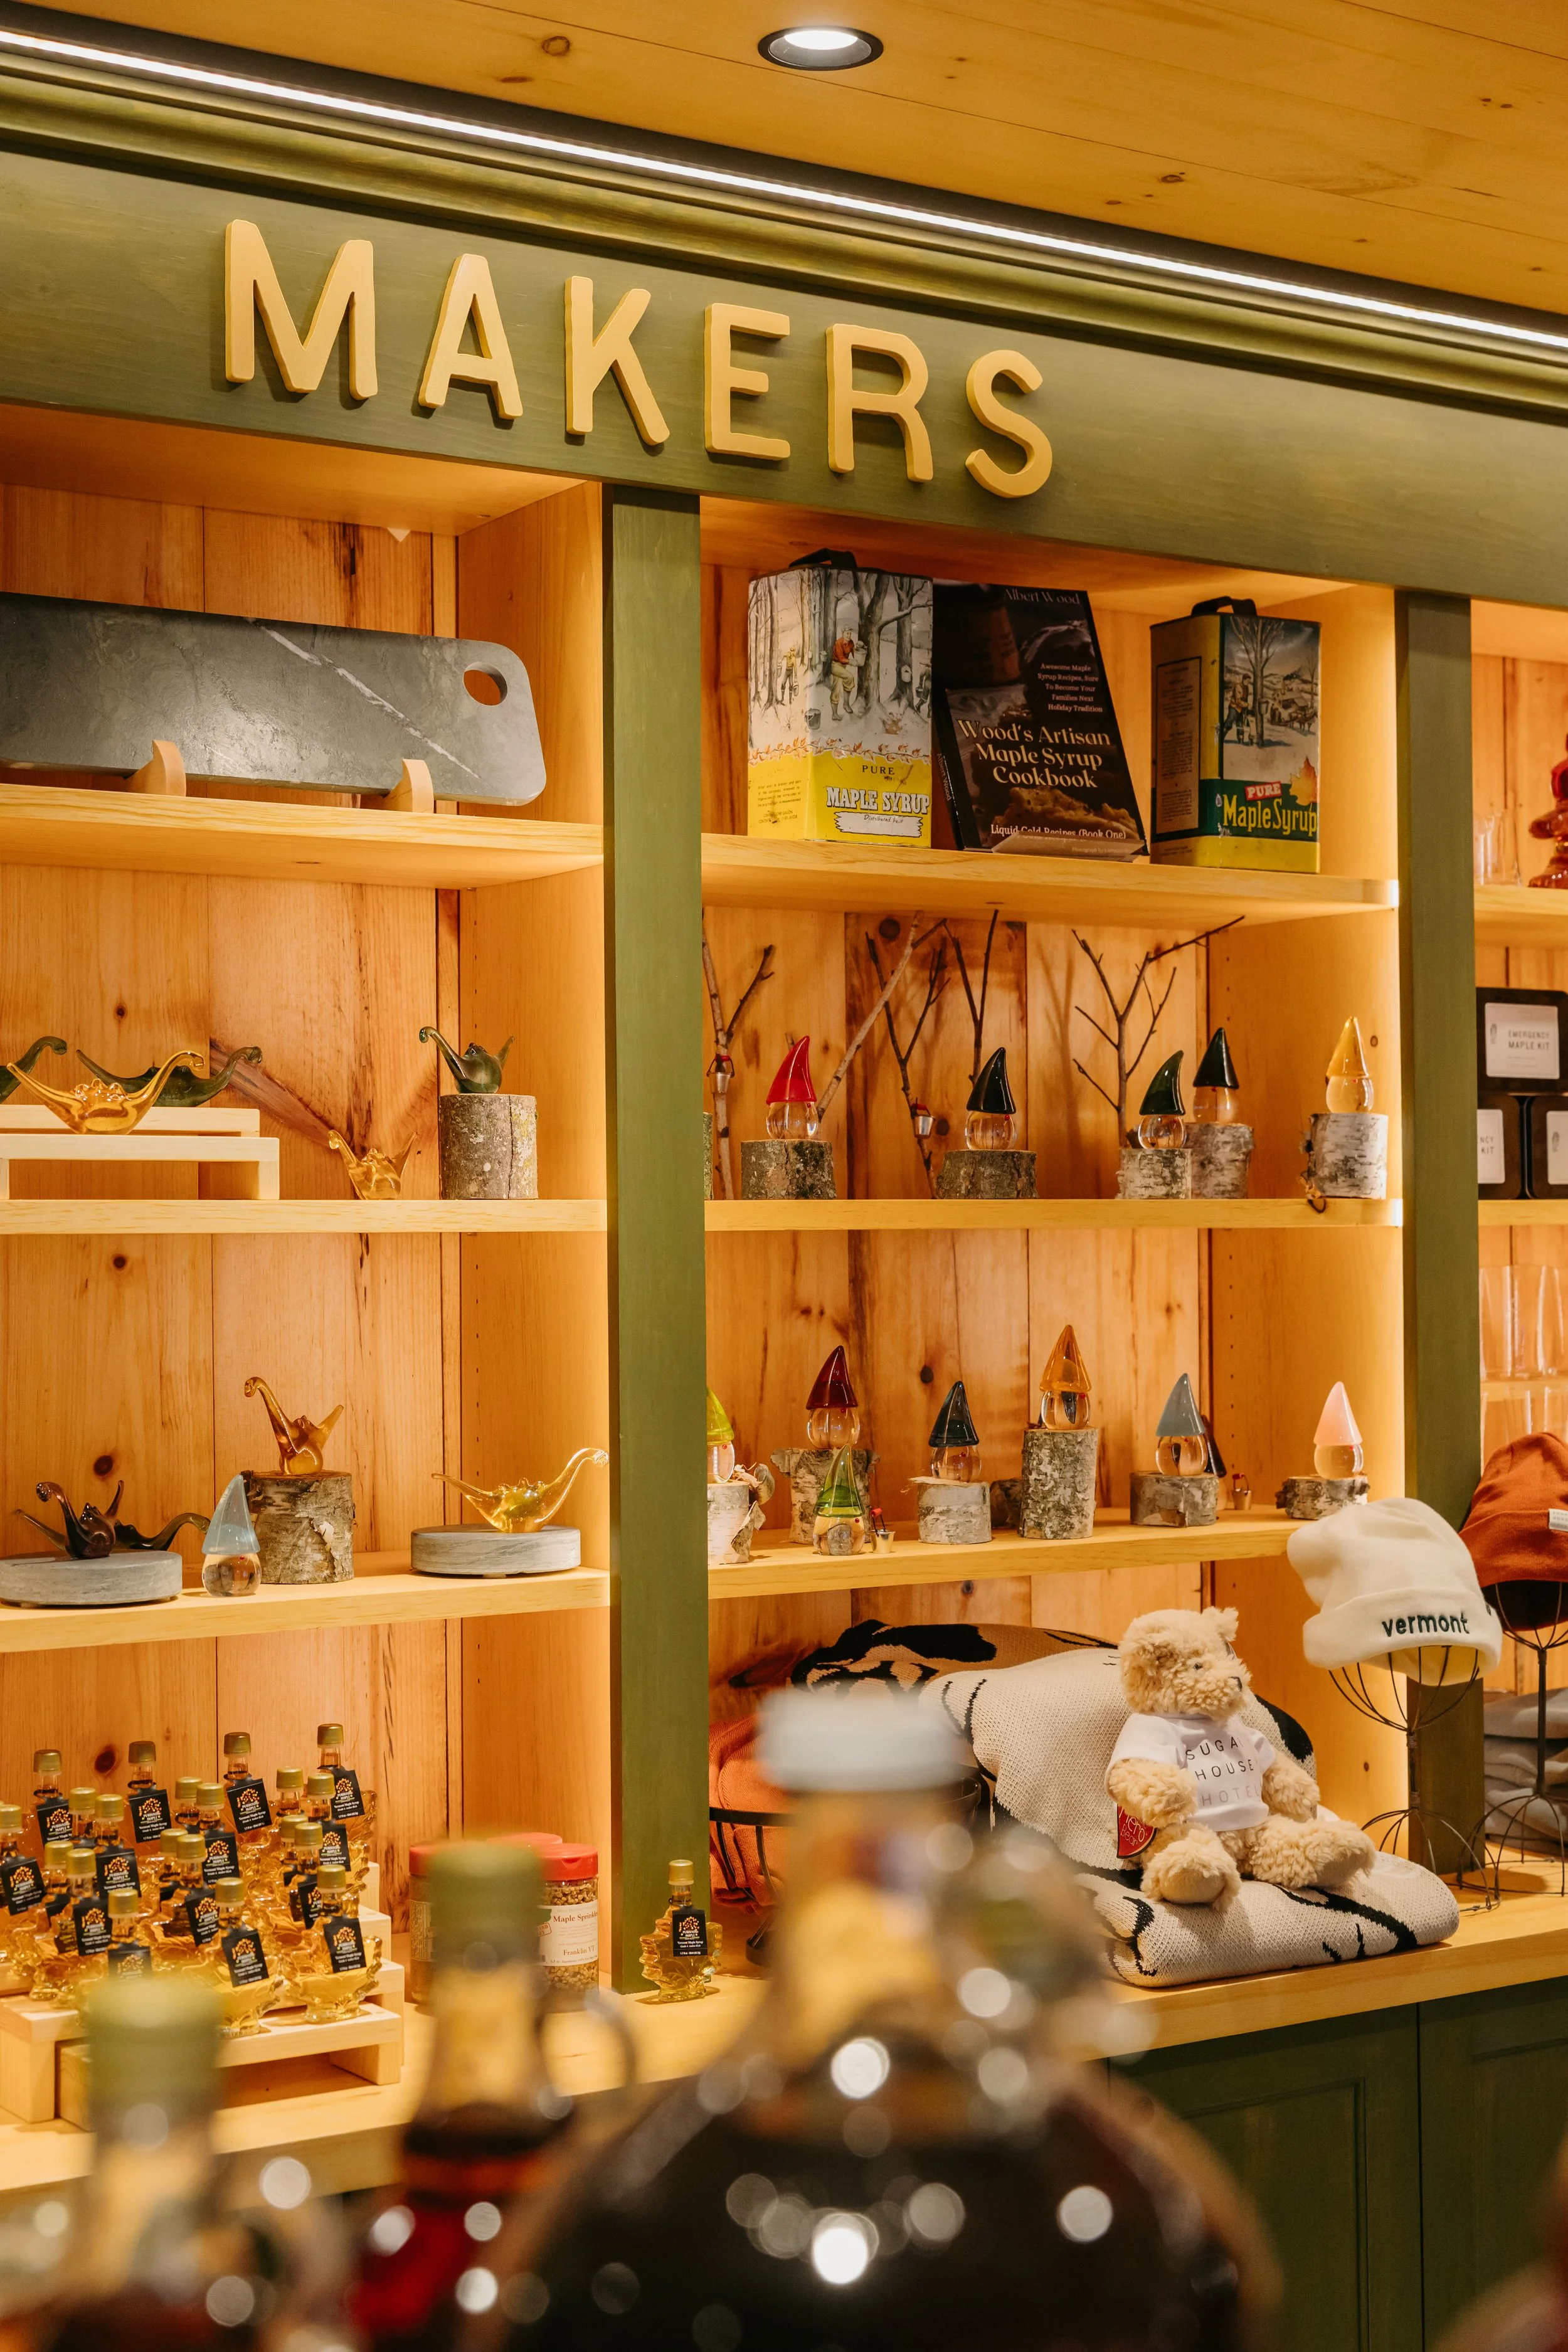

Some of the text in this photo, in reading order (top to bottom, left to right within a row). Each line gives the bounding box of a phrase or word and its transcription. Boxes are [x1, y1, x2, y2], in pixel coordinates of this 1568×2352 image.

[224, 219, 1054, 499] MAKERS
[1004, 588, 1079, 604] Albert Wood
[1041, 662, 1070, 670] Awesome
[1057, 674, 1084, 682] Recipes,
[1048, 704, 1073, 712] Holiday
[956, 719, 1111, 746] Wood's Artisan
[975, 743, 1103, 771] Maple Syrup
[862, 765, 895, 775] PURE
[993, 765, 1098, 788] Cookbook
[943, 777, 952, 801] Wood
[1247, 783, 1281, 798] PURE
[826, 787, 930, 815] MAPLE SYRUP
[864, 814, 891, 822] Distributed
[1223, 794, 1271, 832] Maple
[1273, 798, 1317, 837] Syrup
[990, 824, 1018, 837] Liquid
[1105, 829, 1126, 839] One)
[1508, 1030, 1549, 1039] EMERGENCY
[1508, 1041, 1549, 1051] MAPLE KIT
[1481, 1147, 1494, 1155] KIT
[1381, 1610, 1470, 1637] vermont
[1185, 1736, 1244, 1760] SUGA
[1194, 1759, 1254, 1781] HOUSE
[1201, 1785, 1261, 1806] HOTEL
[1120, 1823, 1138, 1847] Bear
[553, 1915, 576, 1924] Maple
[563, 1947, 587, 1956] Franklin
